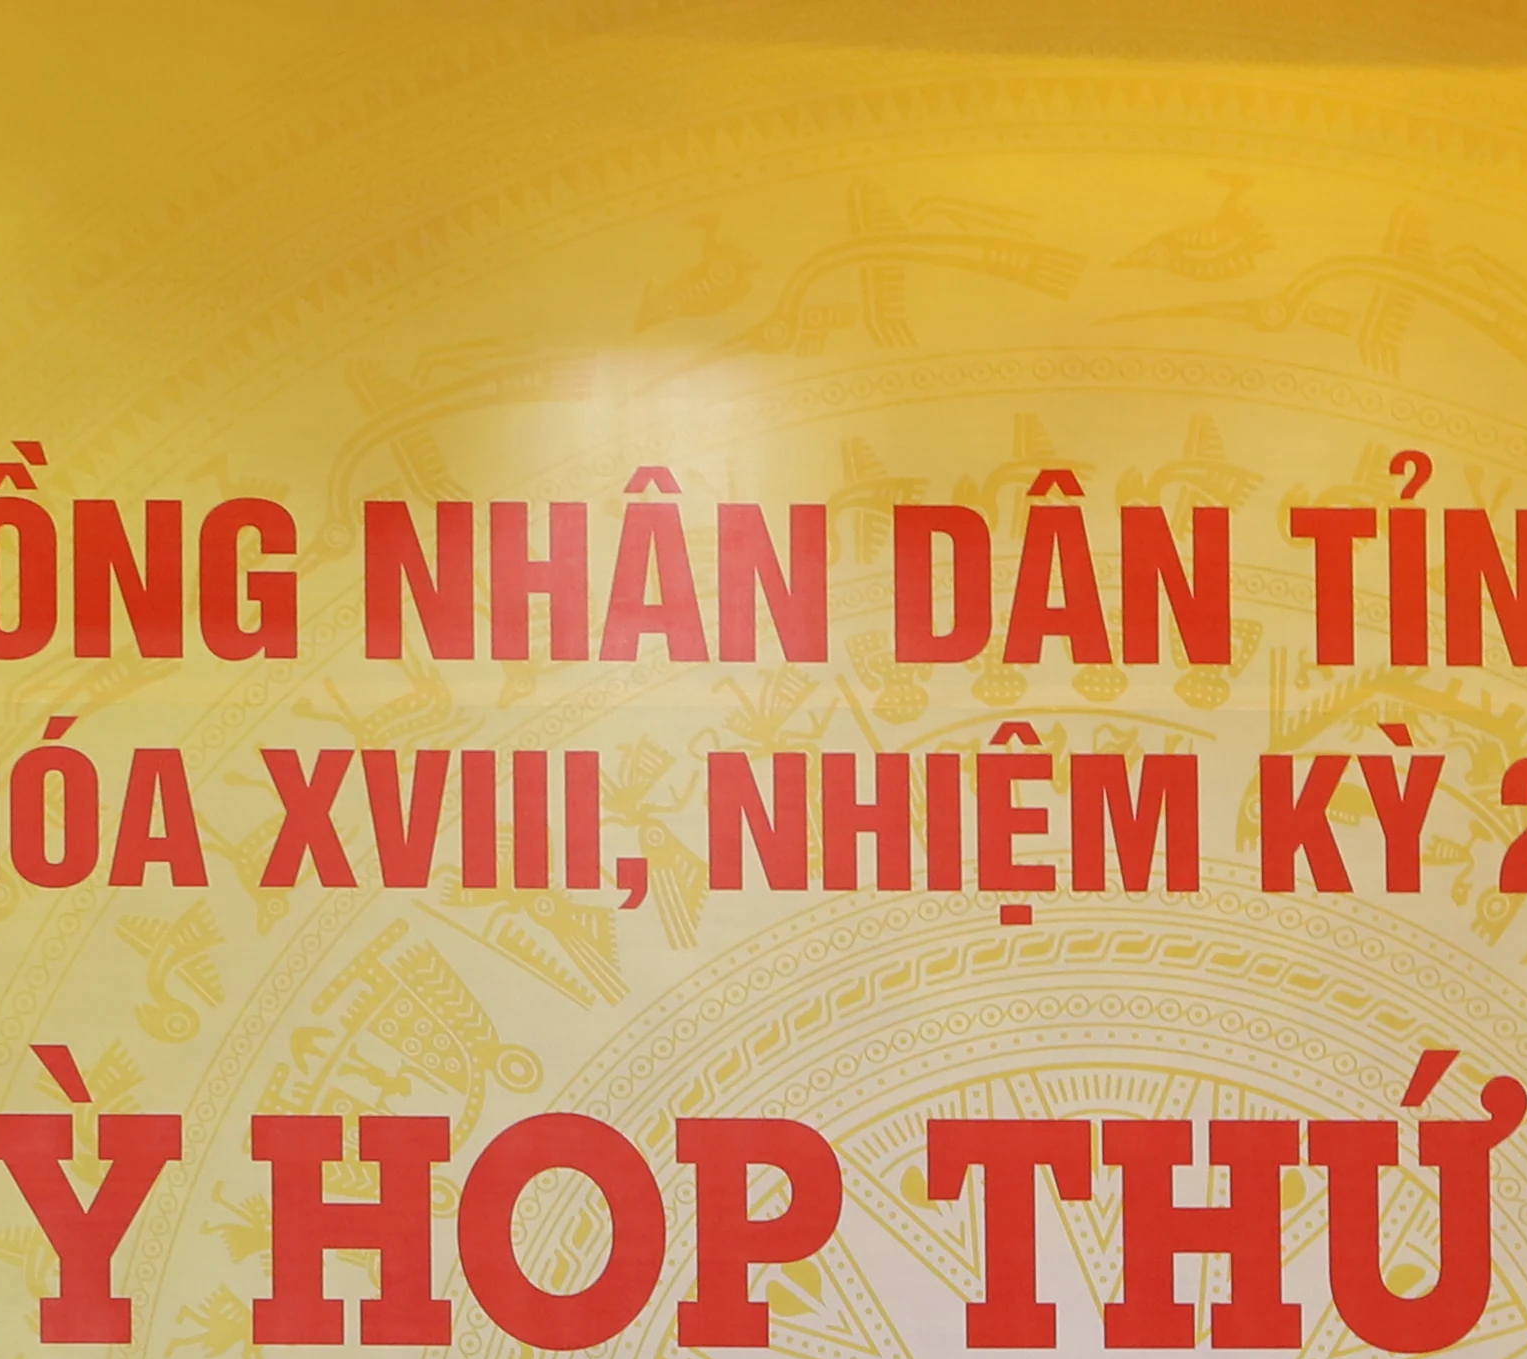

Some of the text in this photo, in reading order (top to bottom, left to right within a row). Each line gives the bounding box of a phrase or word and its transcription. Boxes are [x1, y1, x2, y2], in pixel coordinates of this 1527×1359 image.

[363, 467, 828, 663] NHÂN
[892, 467, 1233, 667] DÂN
[260, 748, 649, 910] XVIII,
[708, 720, 1201, 927] NHIỆM
[1259, 722, 1446, 894] KỲ
